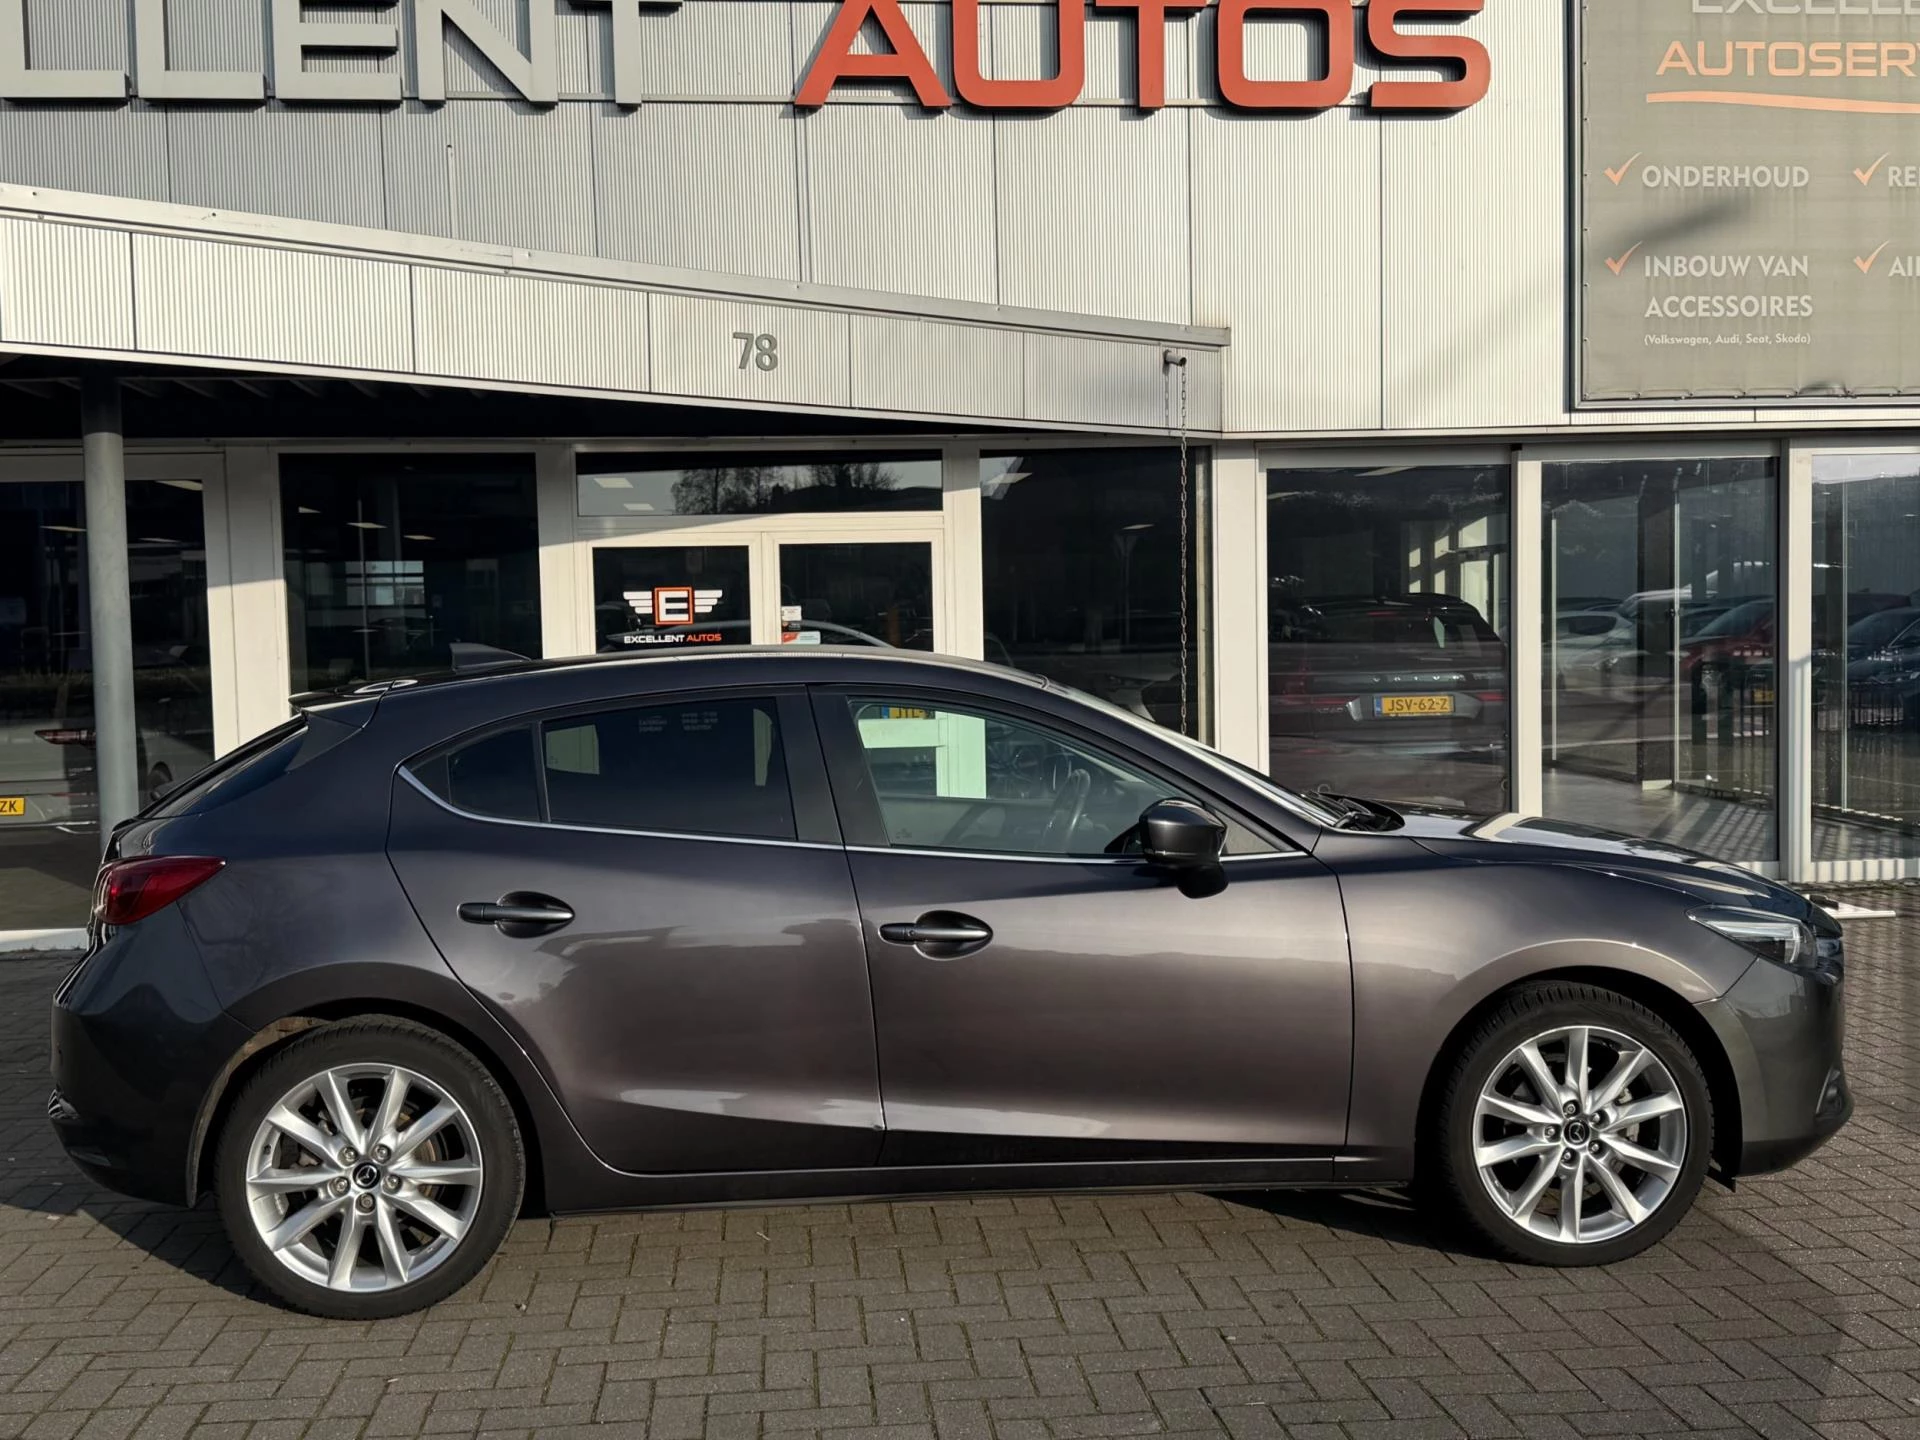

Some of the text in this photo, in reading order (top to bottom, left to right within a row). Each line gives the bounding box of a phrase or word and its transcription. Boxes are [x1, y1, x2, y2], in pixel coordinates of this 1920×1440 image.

[795, 0, 1491, 108] AUTOS
[1656, 41, 1920, 77] AUTOSER
[1642, 165, 1809, 188] ONDERHOUD
[1888, 165, 1920, 187] RE
[1644, 255, 1809, 277] INBOUW VAN
[1888, 255, 1920, 277] AI
[1644, 295, 1813, 318] ACCESSOIRES
[1644, 333, 1812, 346] (Volkswagen, Audi, Seat, Skoda)
[732, 332, 778, 371] 78
[658, 590, 690, 622] E
[623, 633, 723, 644] EXCELLENT AUTOS
[1387, 697, 1449, 712] JSV-62-Z
